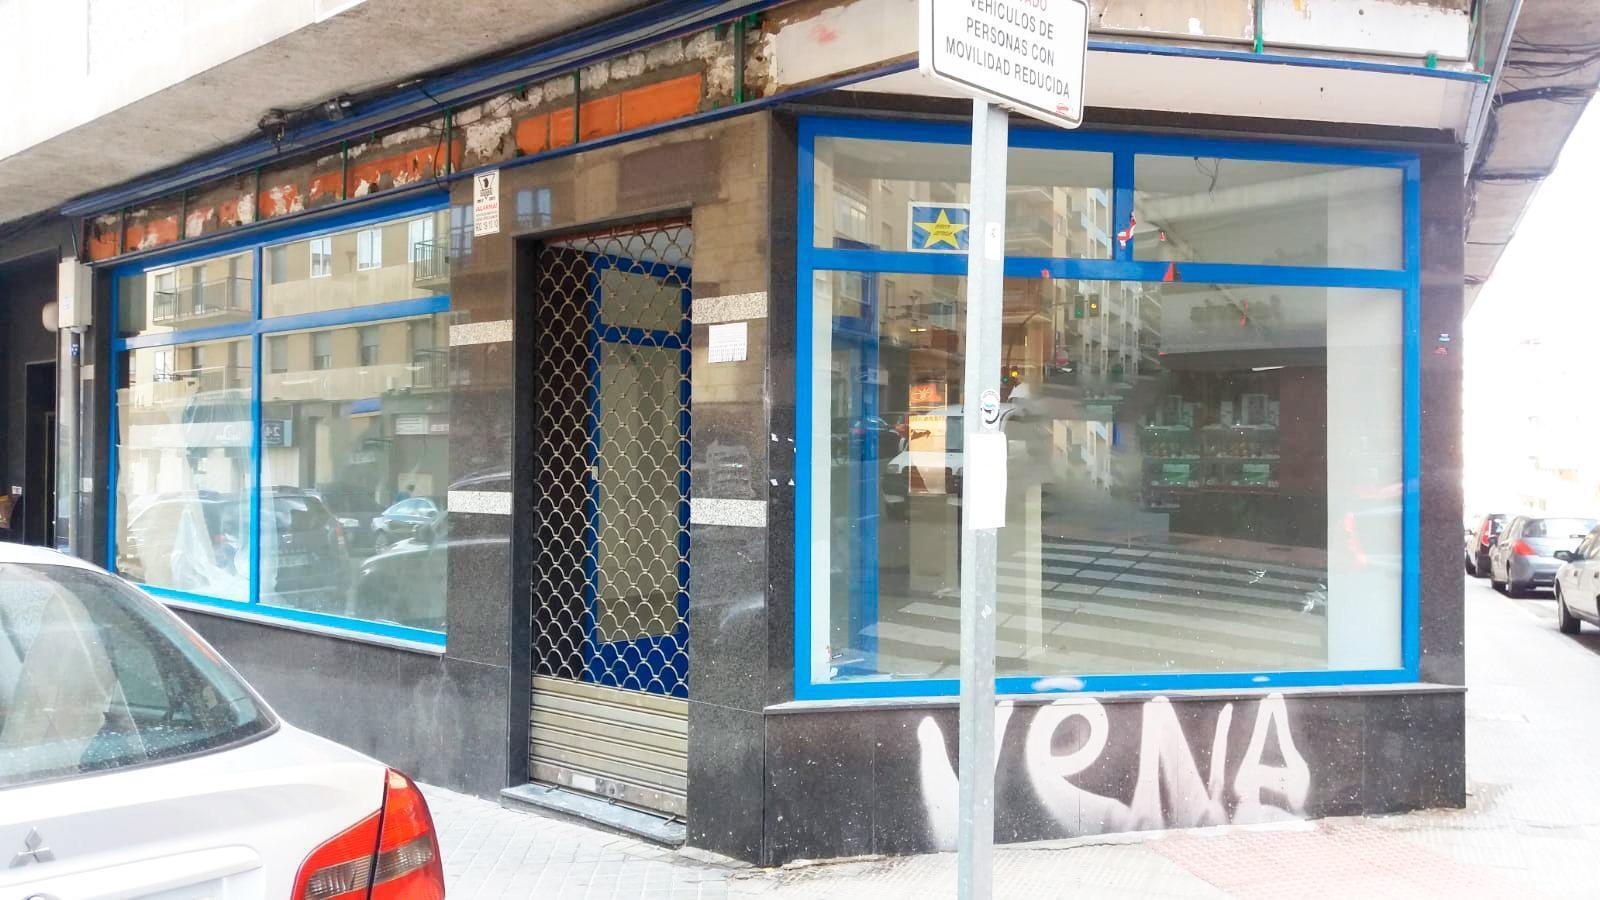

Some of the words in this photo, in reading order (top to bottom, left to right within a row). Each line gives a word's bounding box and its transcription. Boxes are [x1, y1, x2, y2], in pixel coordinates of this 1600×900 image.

[966, 16, 1028, 56] PERSONAS
[1031, 44, 1055, 67] CON
[1039, 20, 1055, 40] DE
[946, 36, 1010, 76] MOVILIDAD
[1014, 64, 1071, 98] REDUCIDA
